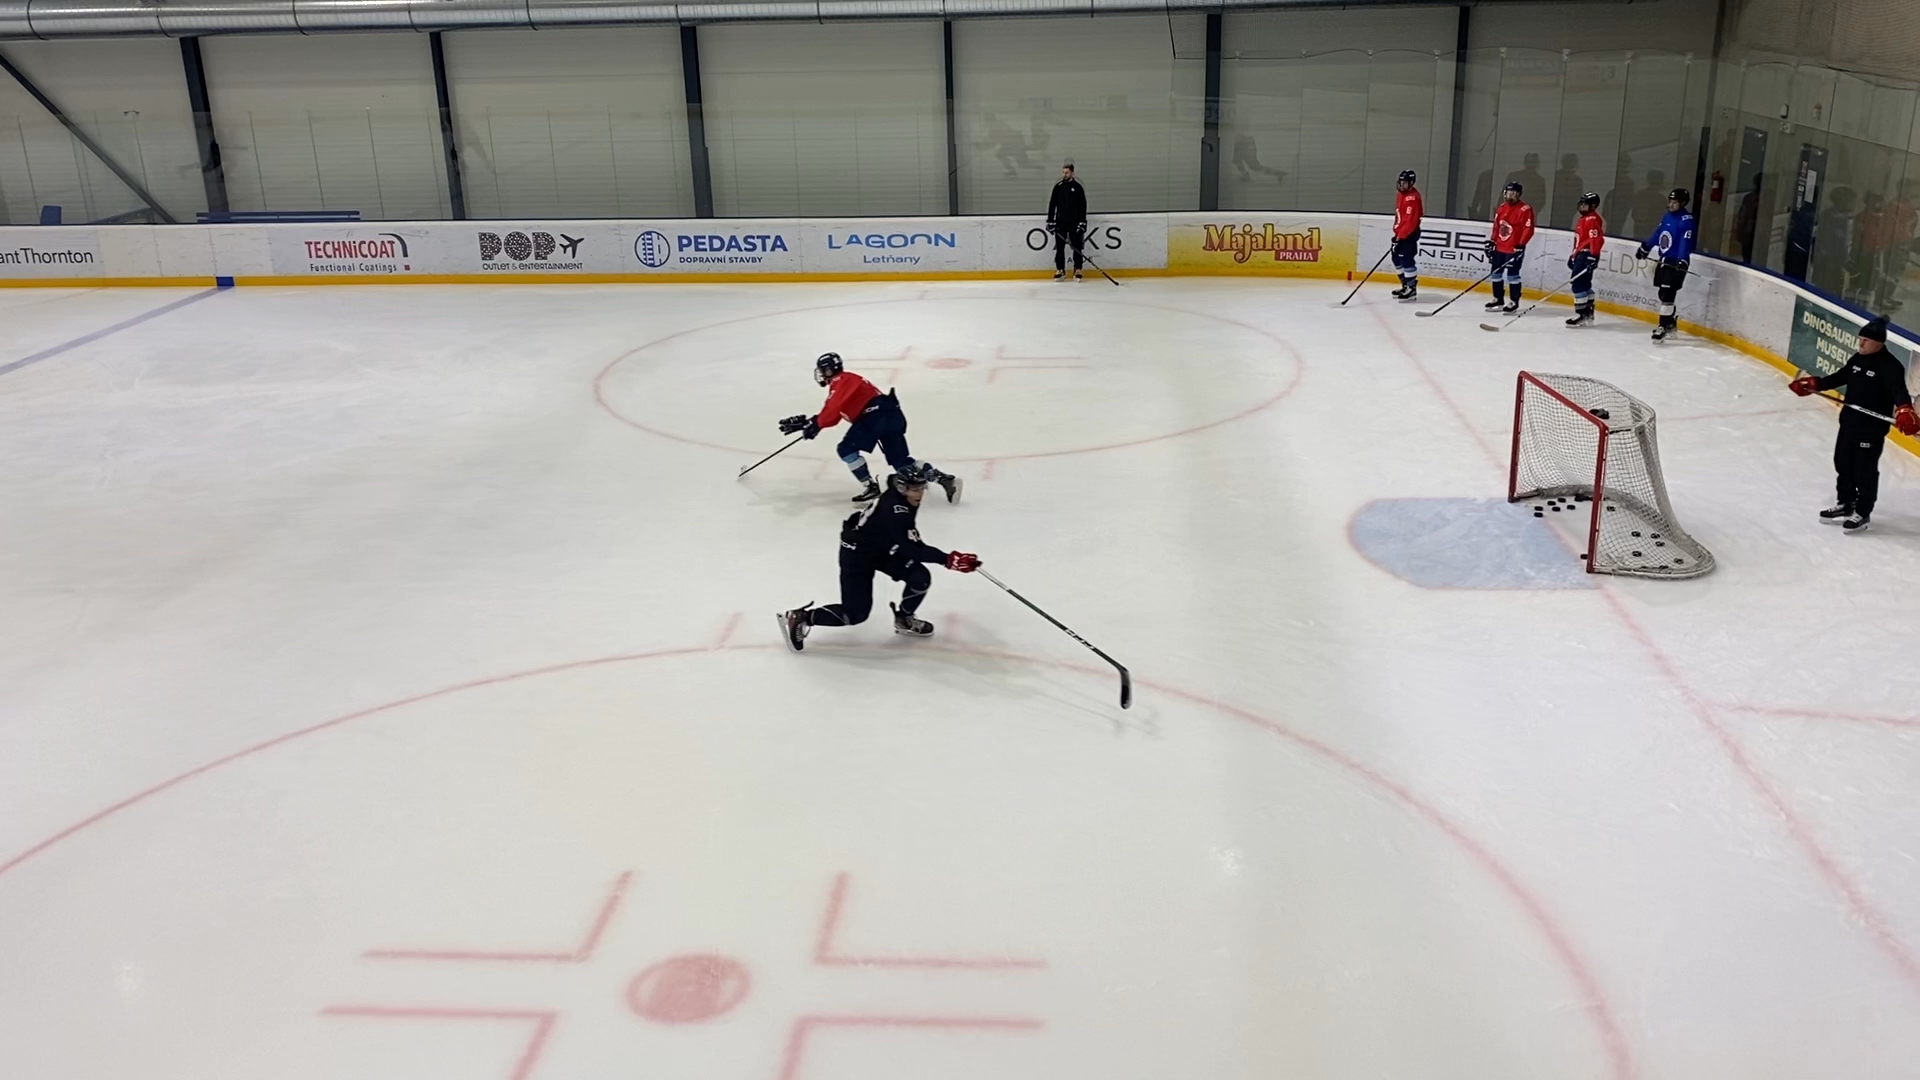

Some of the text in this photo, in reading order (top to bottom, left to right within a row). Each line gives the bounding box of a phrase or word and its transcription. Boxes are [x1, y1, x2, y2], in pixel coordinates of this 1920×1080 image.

[478, 231, 557, 262] POP
[677, 235, 789, 253] PEDASTA
[827, 232, 957, 250] LAGOON
[1026, 226, 1122, 251] OKS
[1202, 223, 1322, 264] Majaland
[679, 255, 764, 264] DOPRAVNÍ STAVBY
[863, 254, 921, 266] Letňany
[1279, 251, 1314, 261] PRAHA
[1418, 248, 1485, 264] NGIN
[310, 262, 397, 274] Functional Coatings
[1816, 336, 1853, 366] MUSEU
